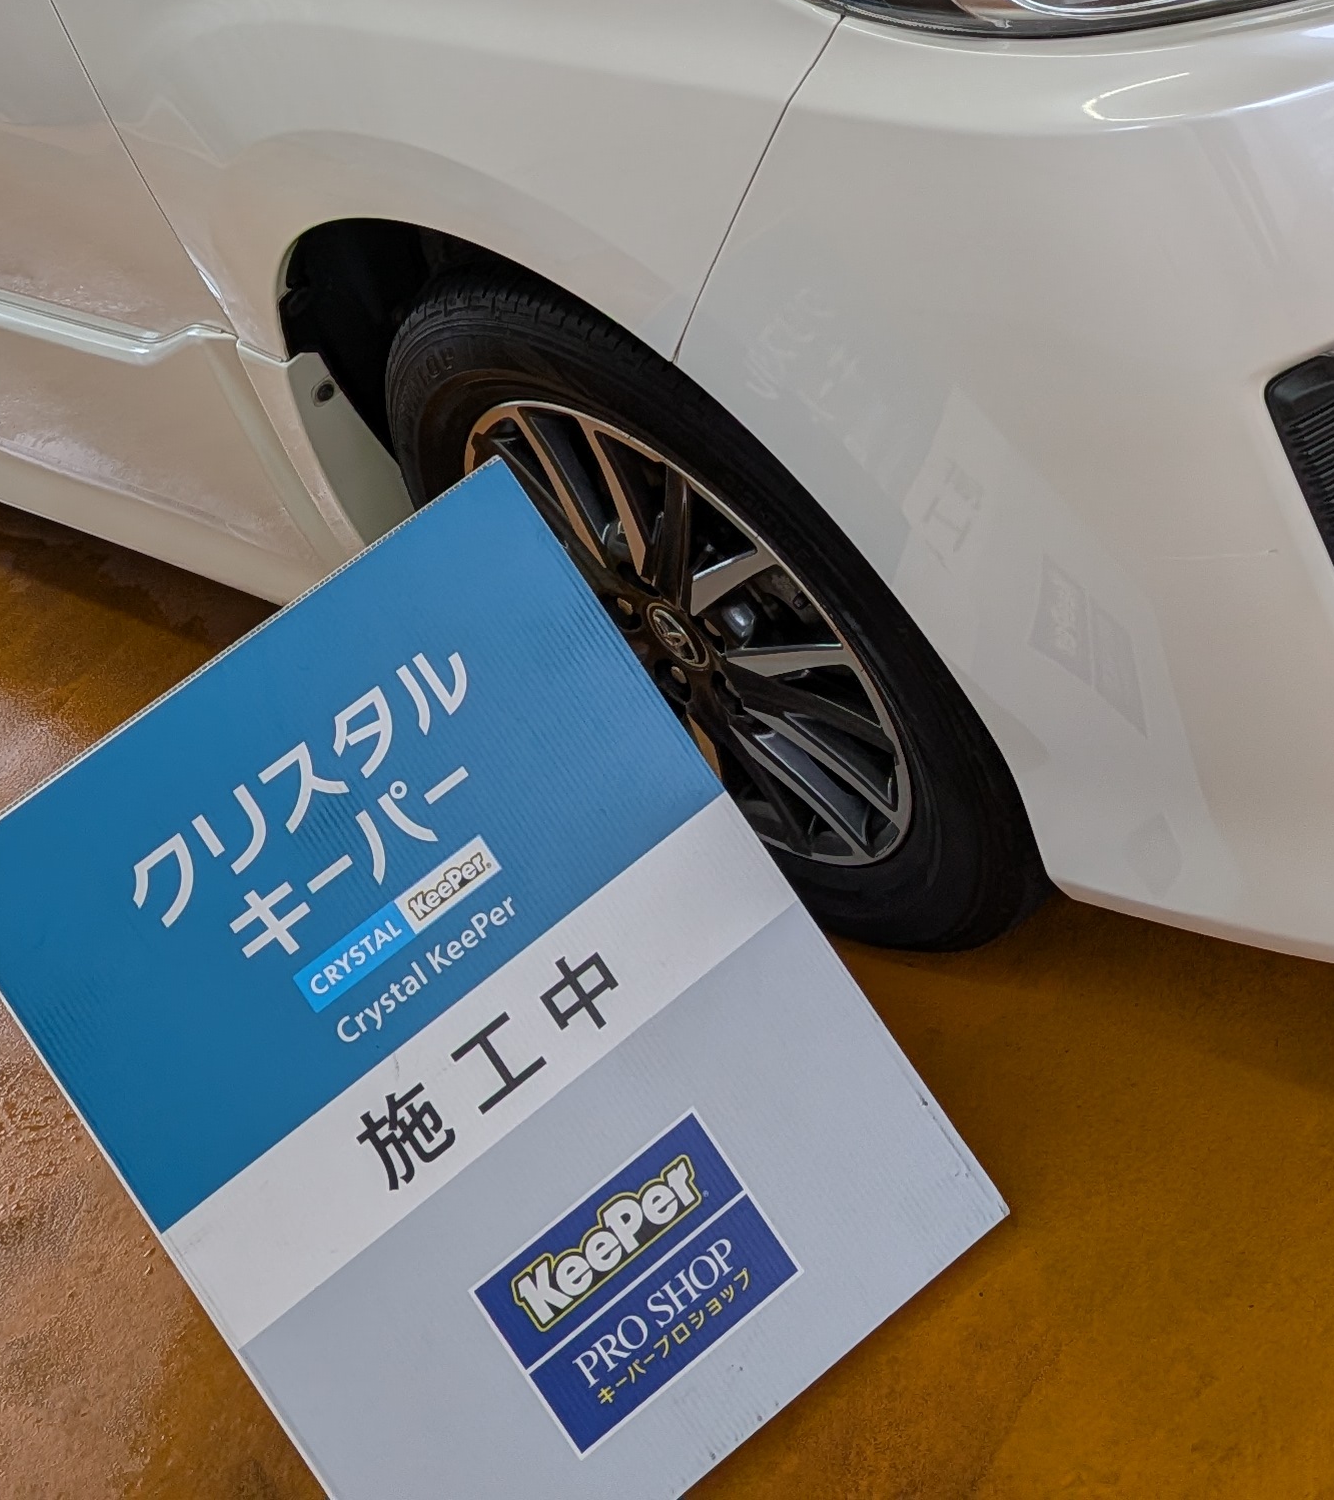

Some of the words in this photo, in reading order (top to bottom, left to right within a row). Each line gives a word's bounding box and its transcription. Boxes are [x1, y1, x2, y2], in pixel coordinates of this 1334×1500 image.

[133, 651, 468, 928] クリスタル
[229, 766, 469, 959] キーパー
[310, 920, 402, 994] CRYSTAL
[408, 852, 484, 921] KeePer
[336, 961, 429, 1043] Crystal
[425, 896, 517, 974] KeePer
[356, 952, 619, 1191] 施工中
[512, 1155, 702, 1332] KeePer
[572, 1315, 648, 1388] PRO
[646, 1238, 733, 1328] SHOP
[598, 1268, 750, 1404] キーパープロショップ
